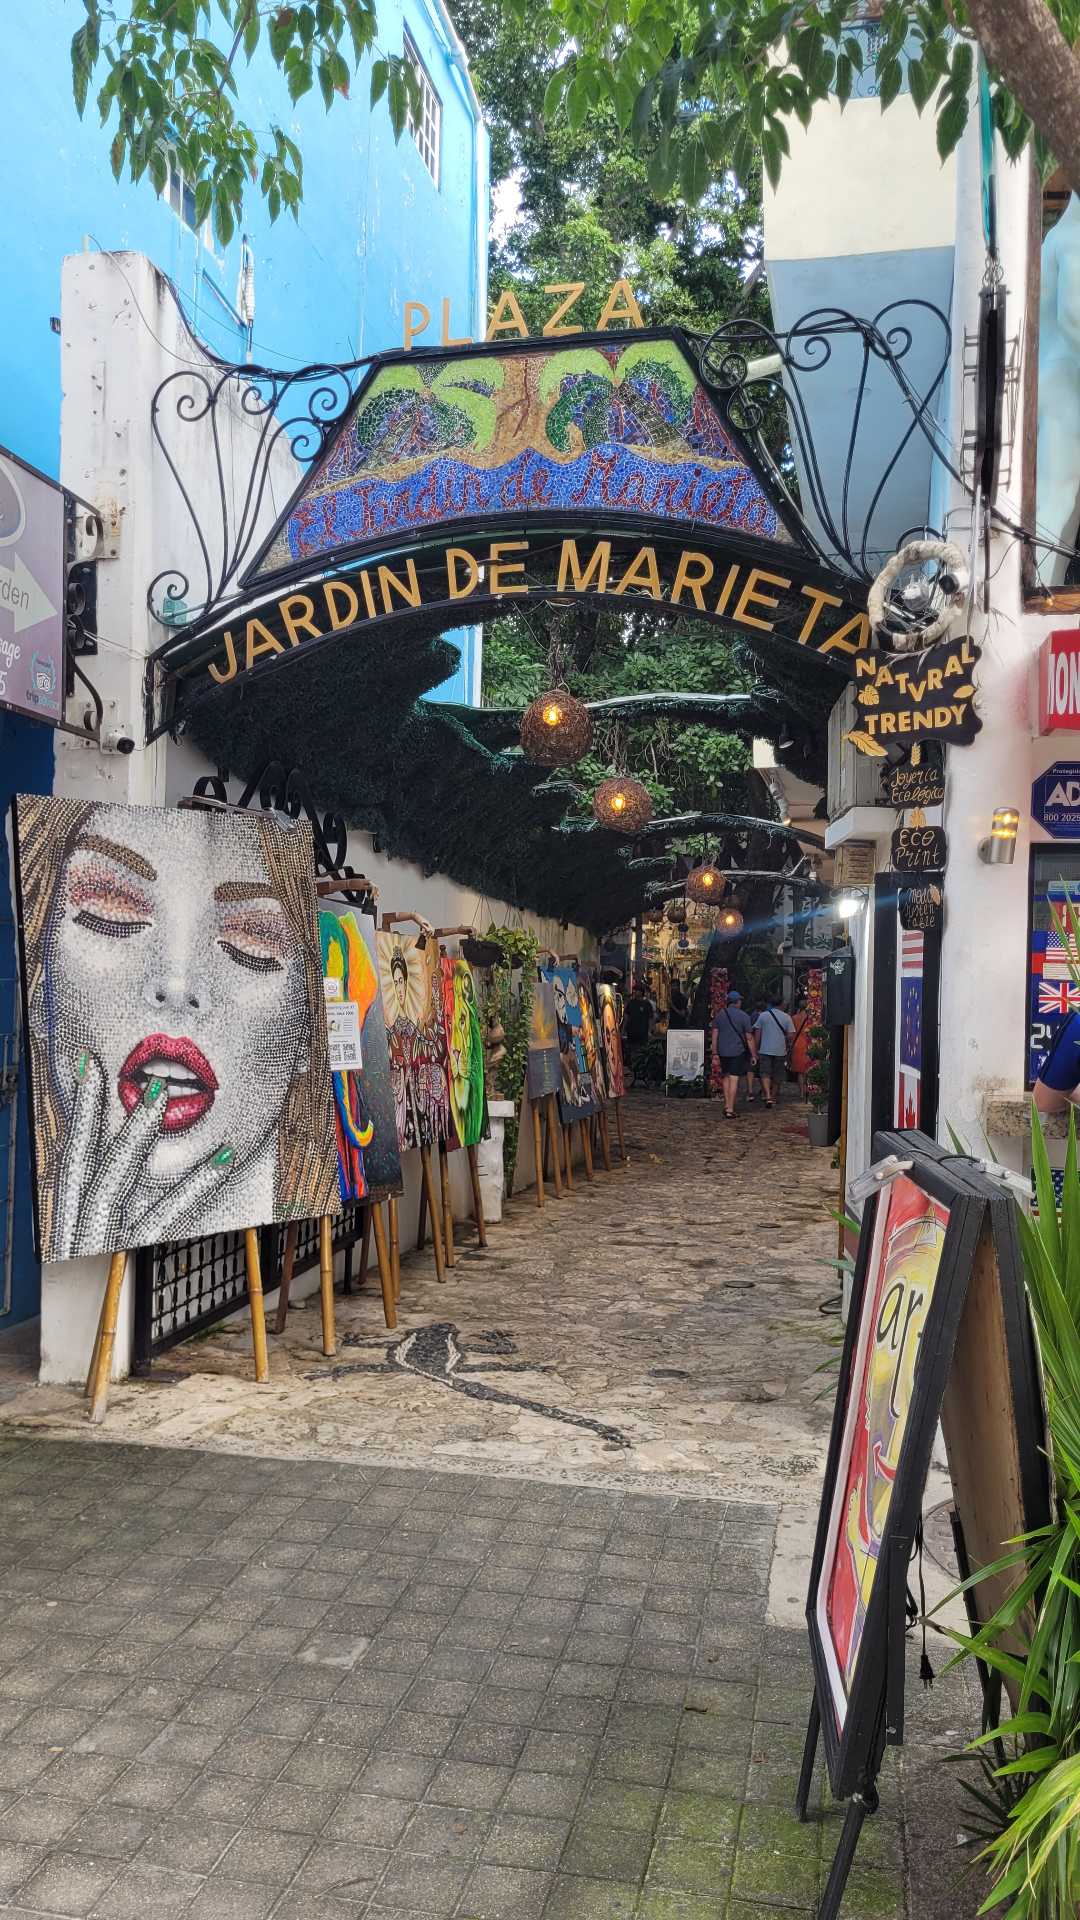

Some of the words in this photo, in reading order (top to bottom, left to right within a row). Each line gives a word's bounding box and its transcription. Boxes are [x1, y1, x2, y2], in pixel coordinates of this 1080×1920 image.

[403, 279, 646, 351] PLAZA
[500, 450, 552, 507] de
[0, 577, 30, 609] den
[207, 558, 420, 685] JARDIN
[445, 540, 531, 599] DE
[556, 539, 873, 655] MARIETA
[0, 638, 21, 668] age
[864, 703, 968, 735] TRENDY
[1043, 813, 1059, 821] 800
[894, 844, 941, 867] Print
